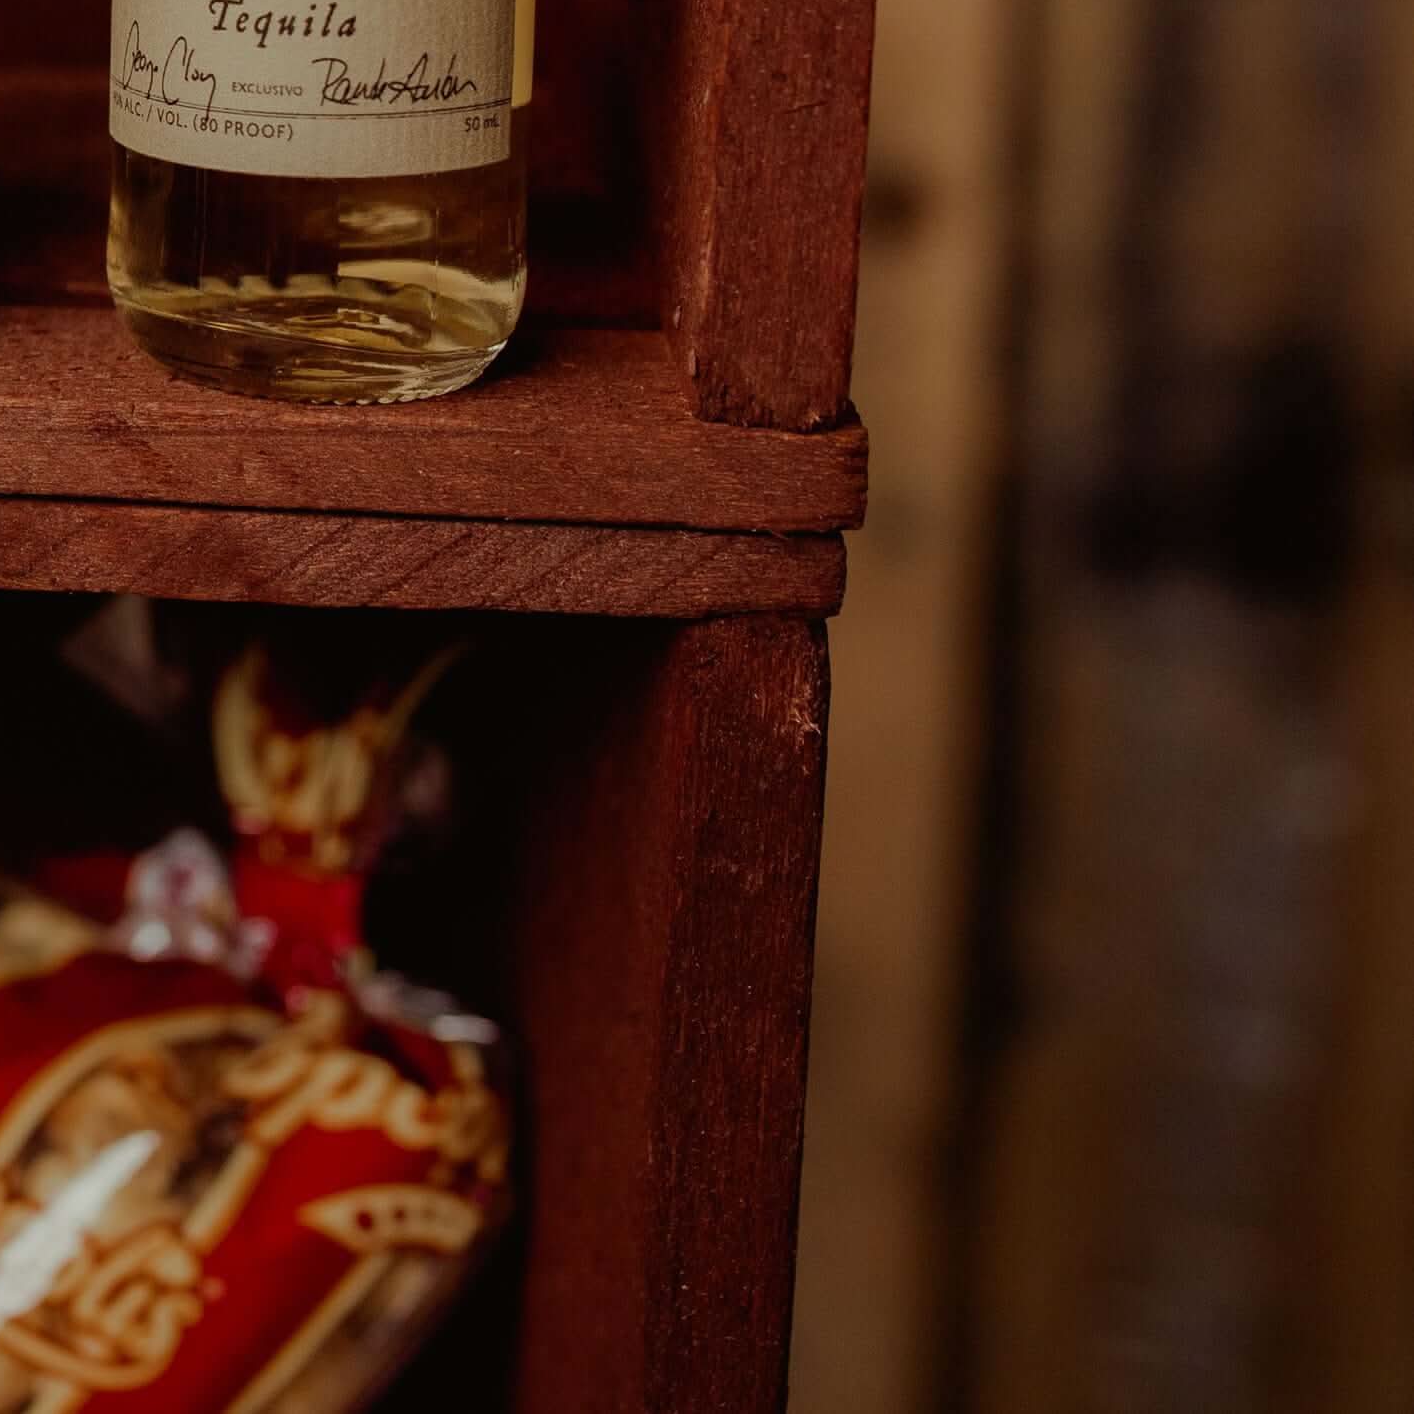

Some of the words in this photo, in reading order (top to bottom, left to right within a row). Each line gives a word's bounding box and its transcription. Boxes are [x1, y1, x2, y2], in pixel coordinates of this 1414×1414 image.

[232, 81, 303, 97] EXCLUSIVO
[157, 109, 188, 128] VOL.
[193, 114, 218, 133] (80
[224, 120, 294, 142] PROOF)
[465, 116, 481, 133] 50
